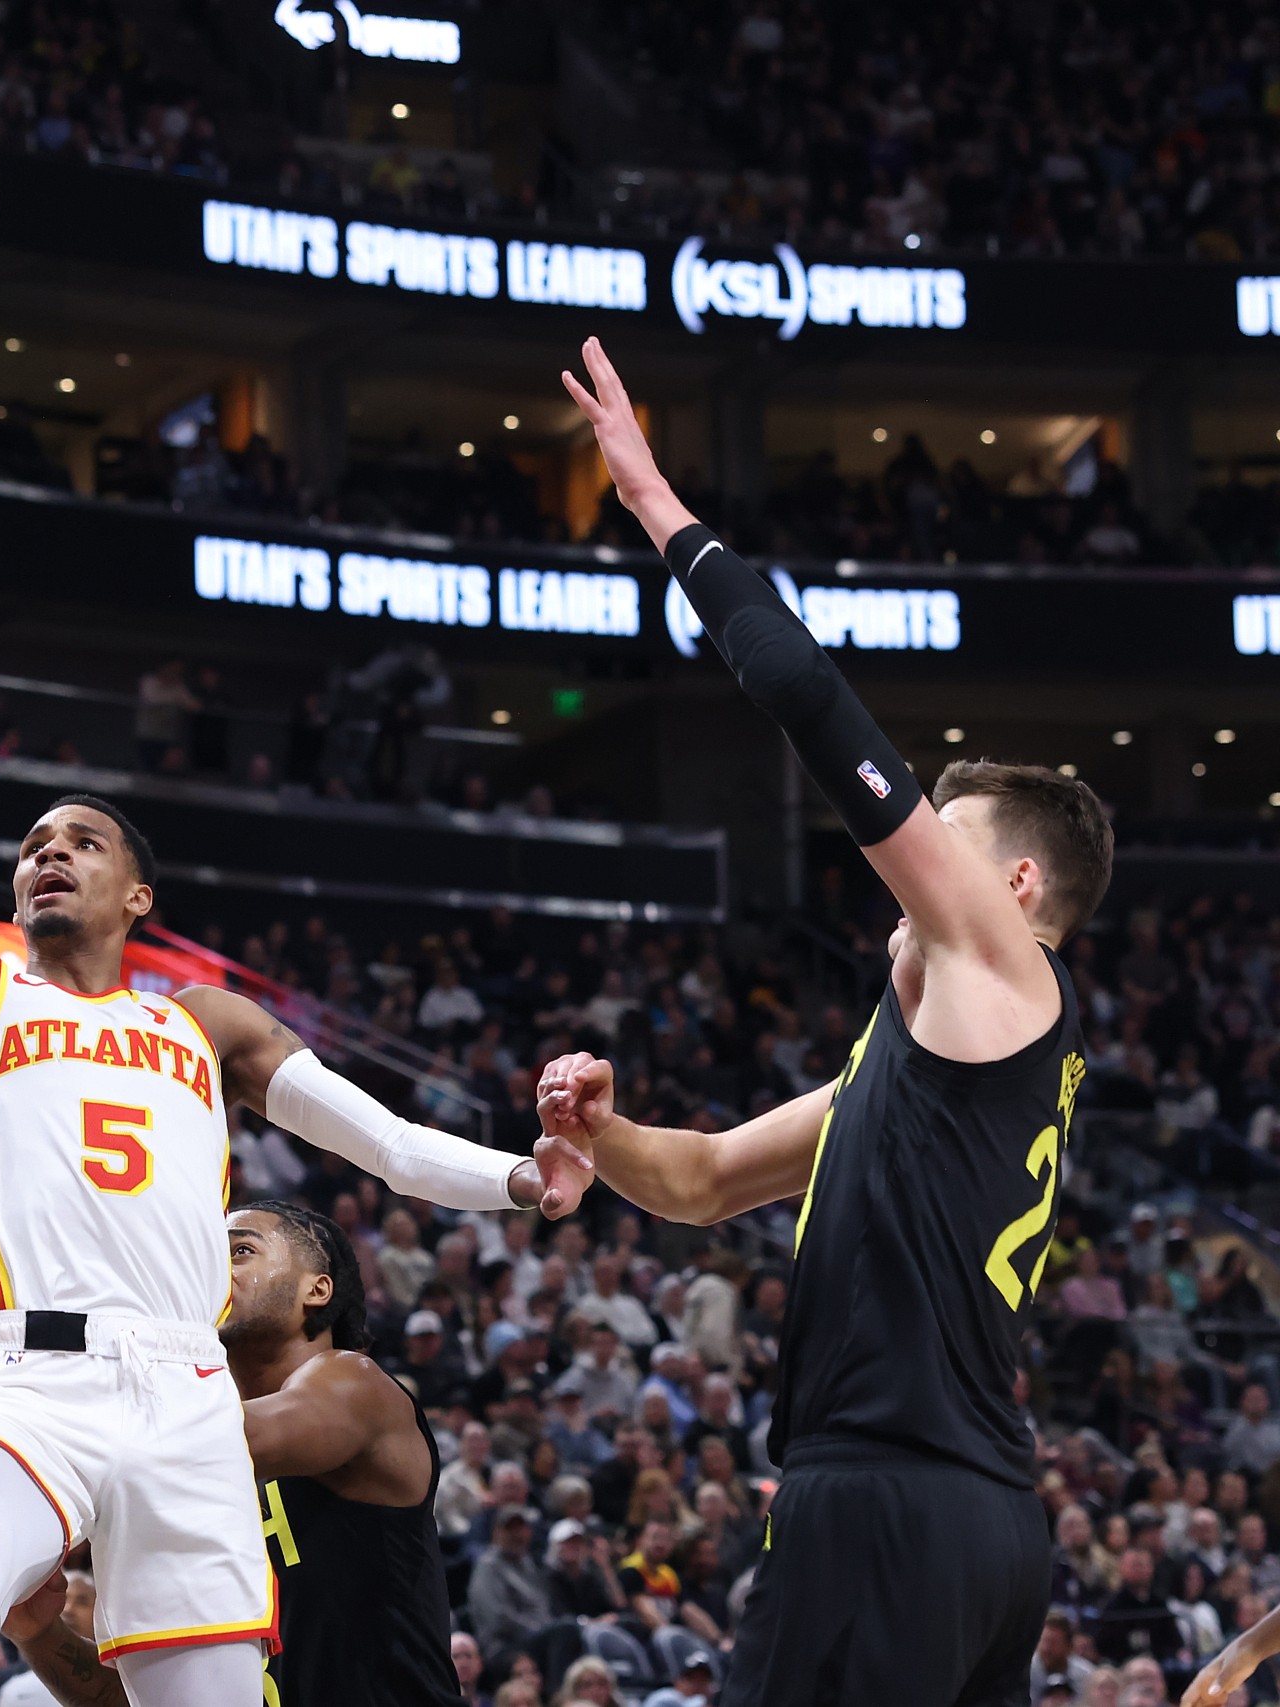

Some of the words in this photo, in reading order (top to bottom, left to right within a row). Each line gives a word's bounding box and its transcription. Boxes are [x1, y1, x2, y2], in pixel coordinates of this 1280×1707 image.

[203, 200, 338, 278] UTAH'S
[346, 222, 499, 299] SPORTS
[507, 240, 646, 311] LEADER
[808, 263, 966, 329] SPORTS
[194, 535, 331, 611] UTAH'S
[338, 553, 490, 627] SPORTS
[499, 568, 639, 637] LEADER
[801, 586, 961, 650] SPORTS
[80, 1098, 154, 1197] 5
[984, 1124, 1058, 1313] 2
